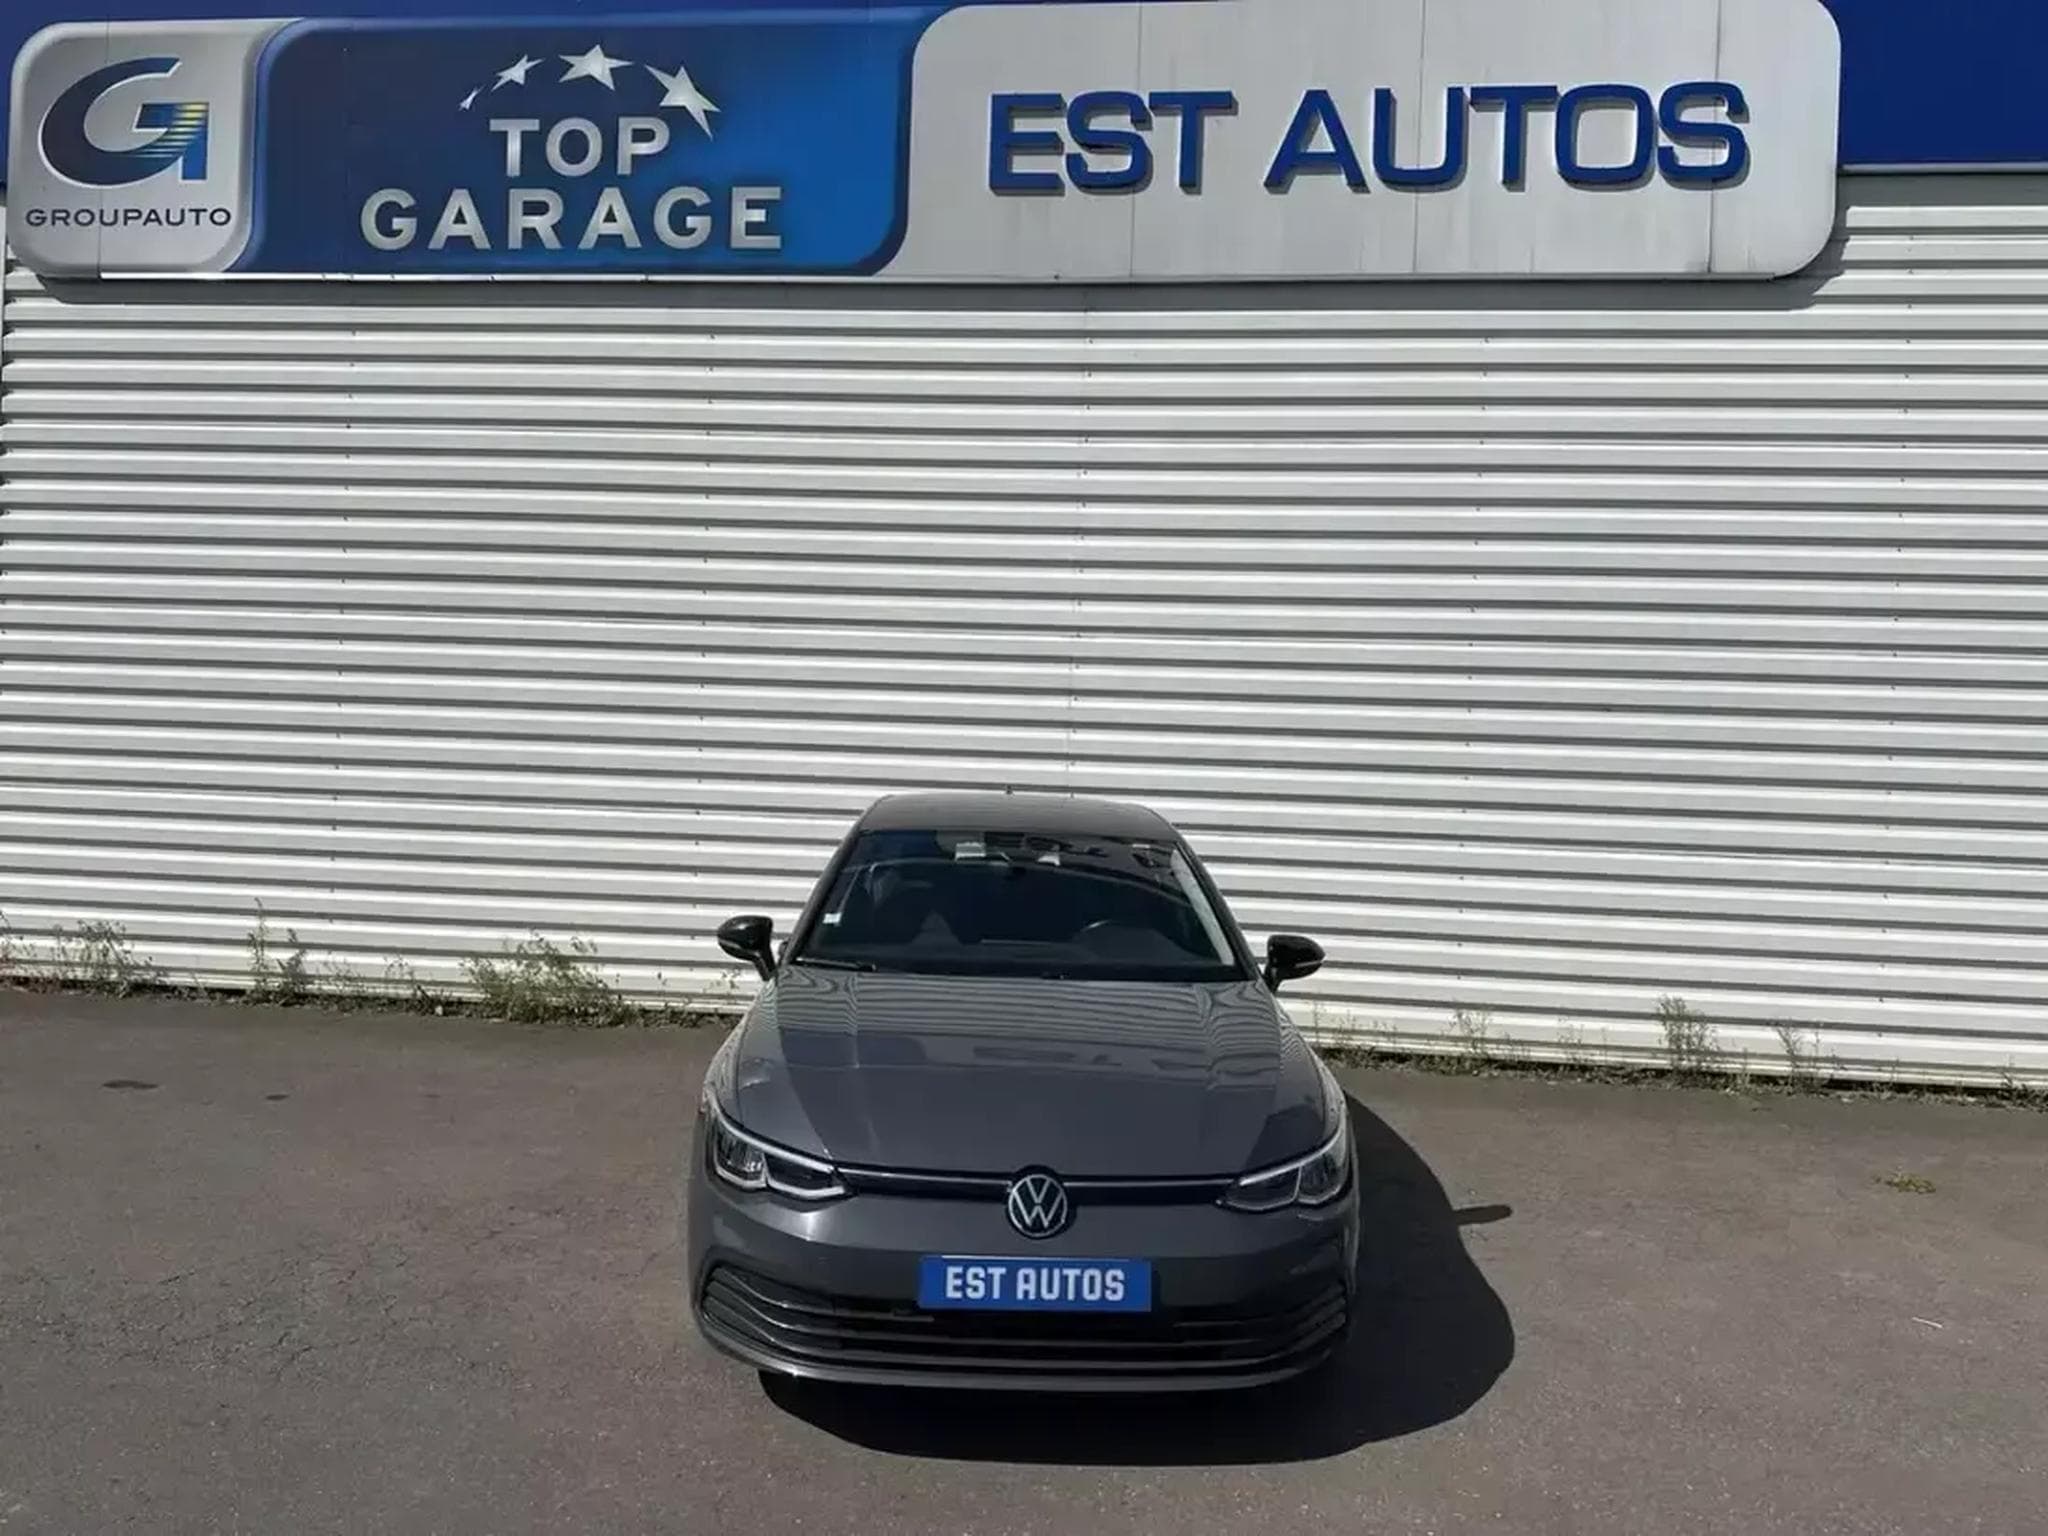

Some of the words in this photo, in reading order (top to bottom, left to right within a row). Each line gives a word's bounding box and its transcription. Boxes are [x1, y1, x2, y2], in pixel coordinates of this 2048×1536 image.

[489, 116, 671, 177] TOP
[990, 91, 1236, 194] EST
[1263, 81, 1750, 192] AUTOS
[25, 206, 232, 228] GROUPAUTO
[360, 186, 783, 251] GARAGE
[945, 1266, 1006, 1300] EST
[1016, 1267, 1125, 1301] AUTOS
